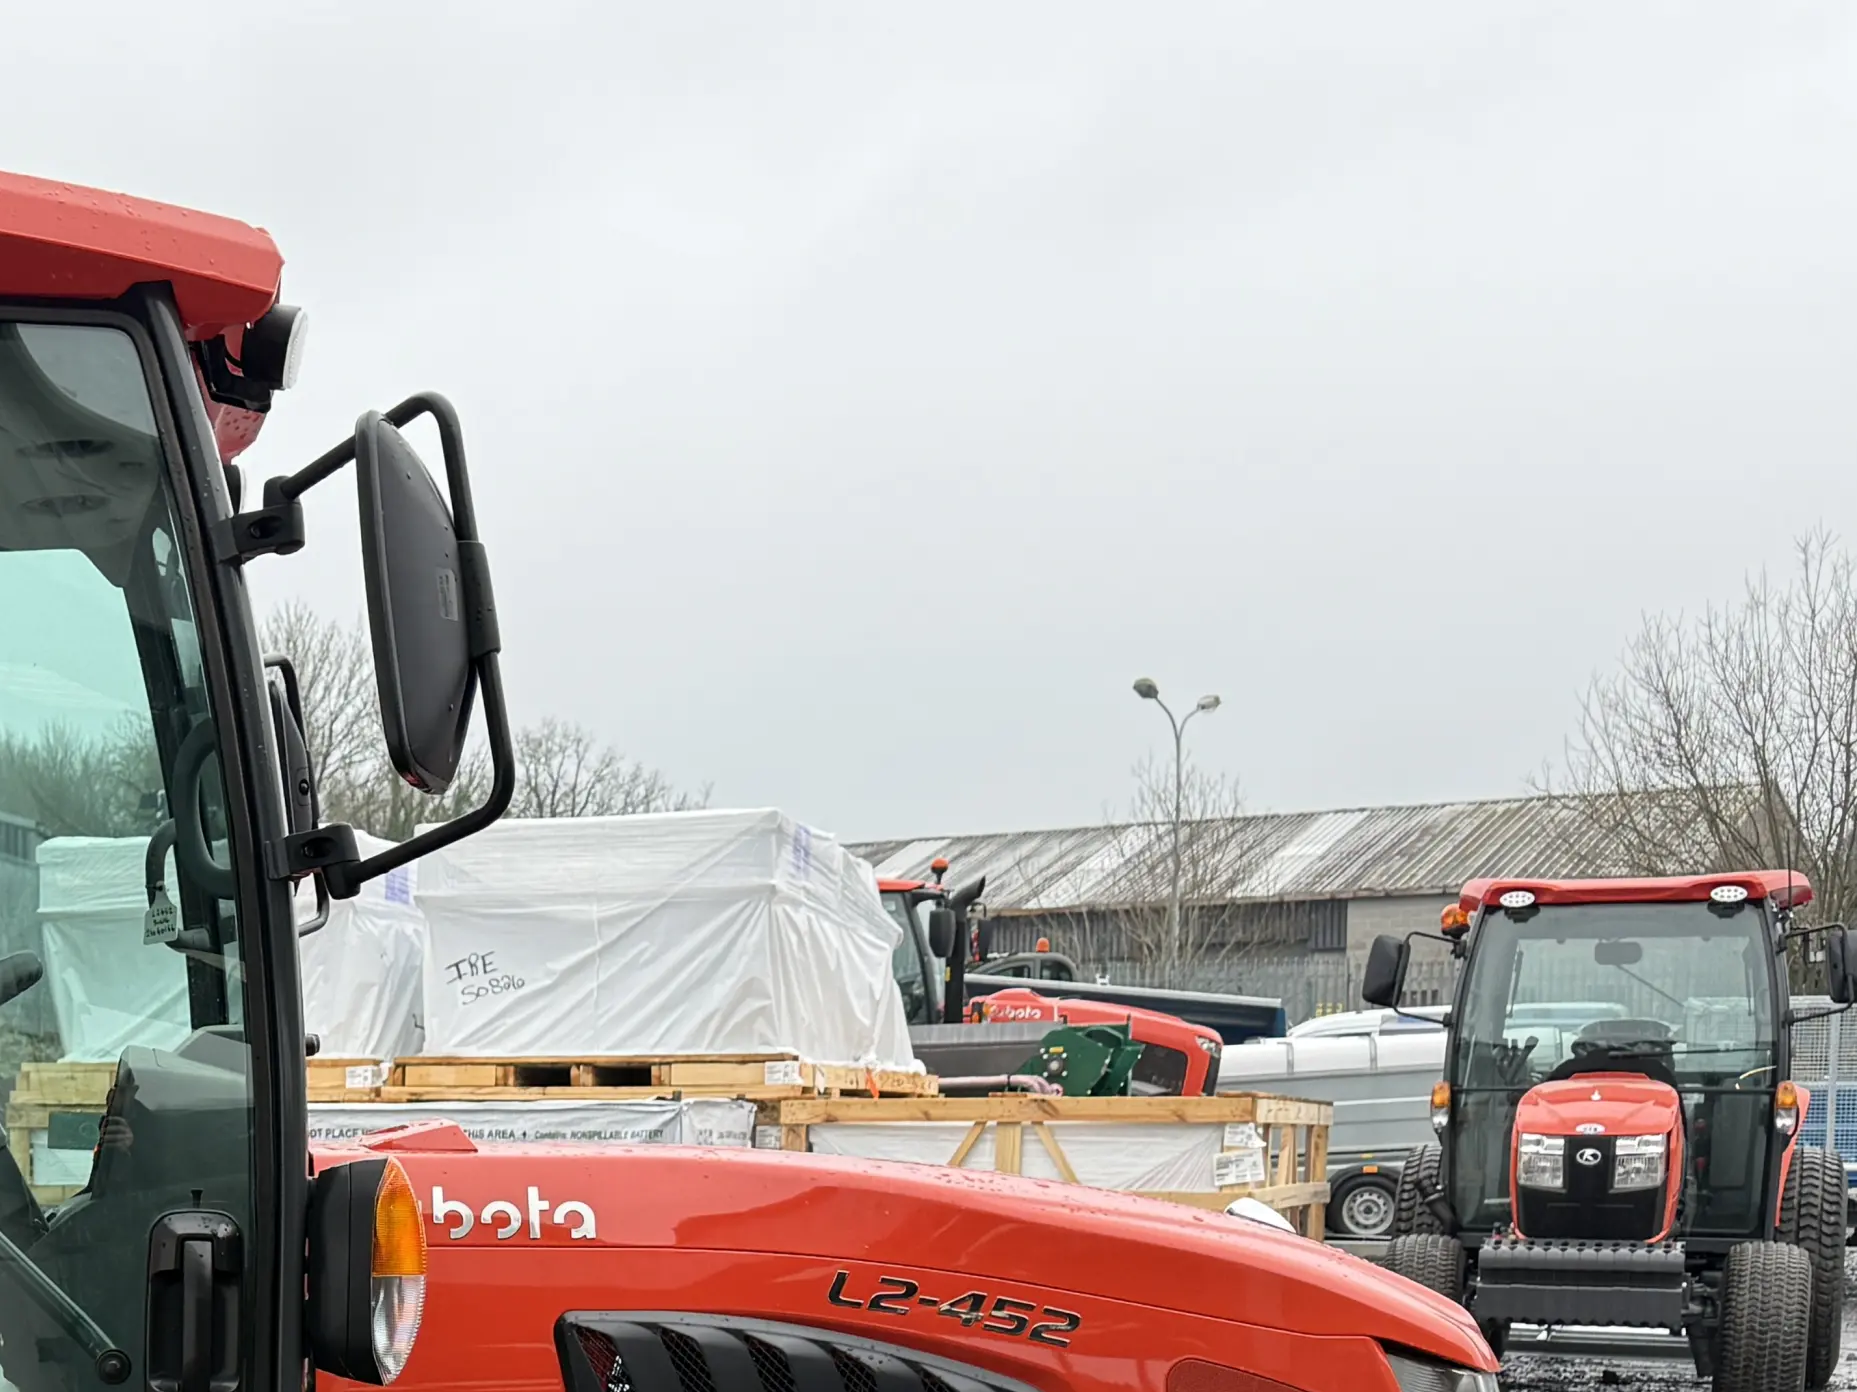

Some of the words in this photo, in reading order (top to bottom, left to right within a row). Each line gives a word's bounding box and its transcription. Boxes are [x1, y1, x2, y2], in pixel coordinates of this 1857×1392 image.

[308, 1128, 323, 1139] OT
[325, 1128, 358, 1139] PLACE
[486, 1128, 515, 1140] AREA
[419, 1185, 597, 1240] bota
[828, 1269, 1082, 1348] L2-452
